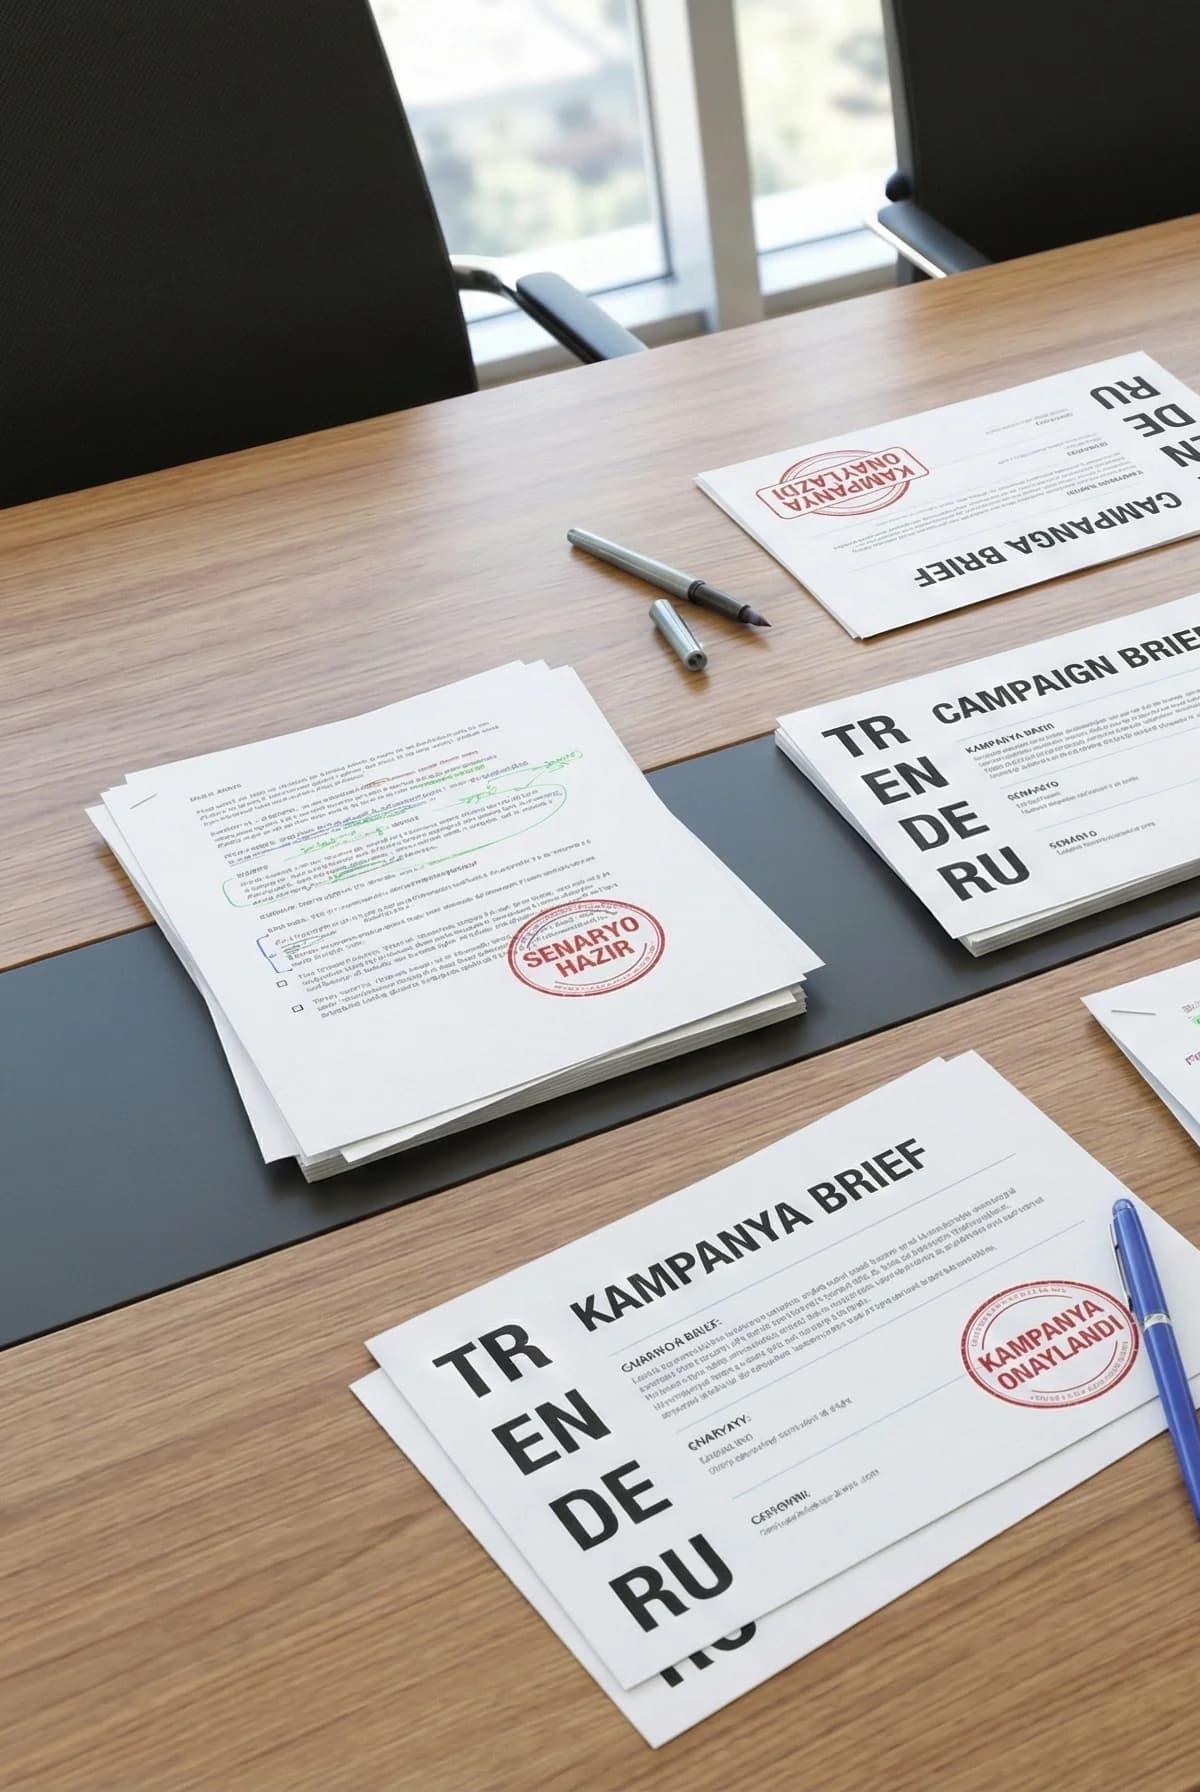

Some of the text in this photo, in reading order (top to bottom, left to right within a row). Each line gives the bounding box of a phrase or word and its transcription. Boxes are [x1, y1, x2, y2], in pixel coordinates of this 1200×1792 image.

[1090, 375, 1161, 410] RU
[1122, 403, 1197, 438] DE
[782, 464, 915, 512] KAMPANYA
[1003, 491, 1182, 555] CAMPANGA
[914, 545, 1008, 588] BRIEF
[931, 655, 1119, 725] CAMPAIGN
[821, 714, 911, 758] TR
[859, 756, 949, 806] EN
[897, 800, 990, 852] DE
[937, 846, 1030, 902] RU
[522, 916, 641, 969] SENARYO
[555, 939, 636, 978] HAZIR
[569, 1202, 814, 1333] KAMPANYA
[807, 1138, 926, 1215] BRIEF
[431, 1323, 553, 1399] TR
[977, 1299, 1105, 1374] KAMPANYA
[996, 1314, 1125, 1391] ONAYLANDI
[490, 1387, 612, 1476] EN
[547, 1458, 673, 1552] DE
[608, 1532, 733, 1633] RU
